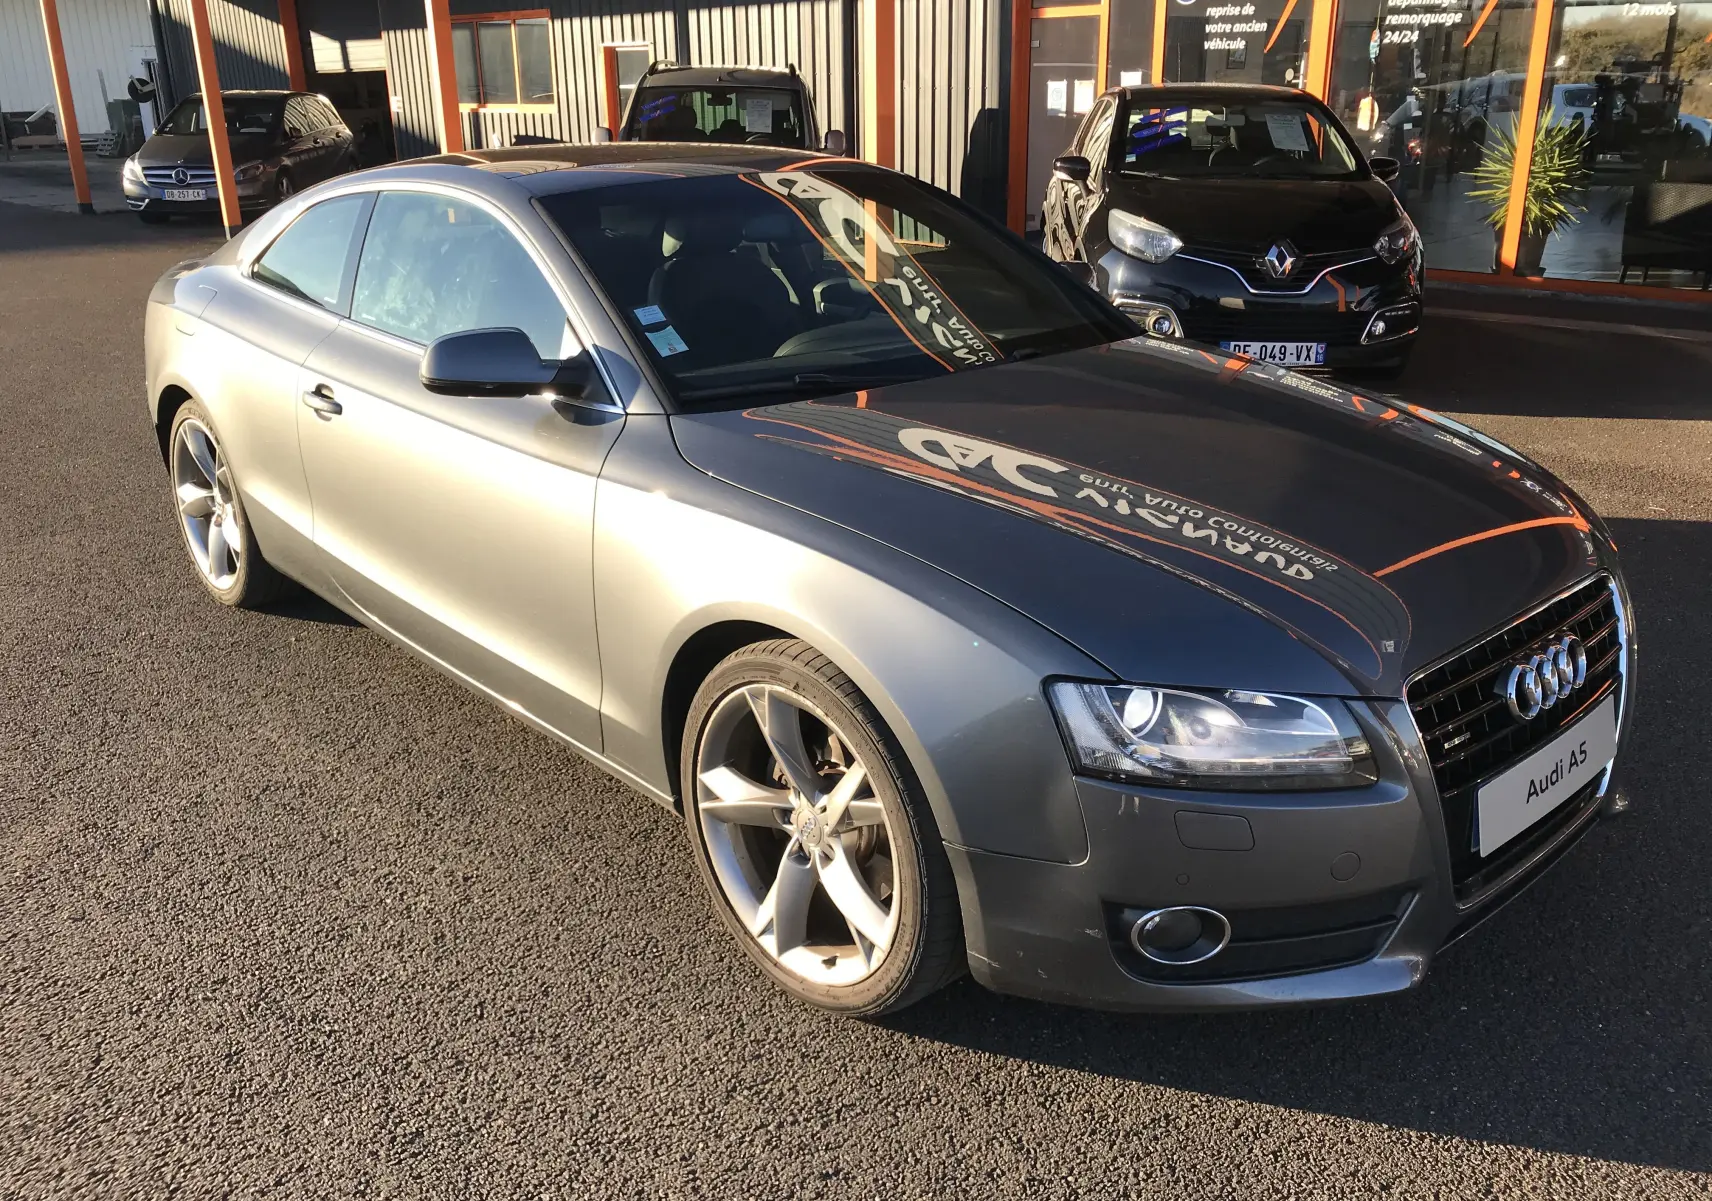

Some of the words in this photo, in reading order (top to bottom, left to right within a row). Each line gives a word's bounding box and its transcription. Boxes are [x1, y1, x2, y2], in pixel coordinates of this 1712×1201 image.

[1206, 4, 1240, 18] reprise
[1242, 3, 1255, 15] de
[1622, 3, 1640, 16] 12
[1640, 2, 1677, 16] mois
[1205, 22, 1231, 33] votre
[1233, 20, 1267, 32] ancien
[1385, 12, 1463, 27] remorquage
[1204, 37, 1246, 50] véhicule
[1382, 30, 1420, 44] 24/24
[1526, 758, 1563, 805] Audi
[1568, 740, 1587, 774] A5
